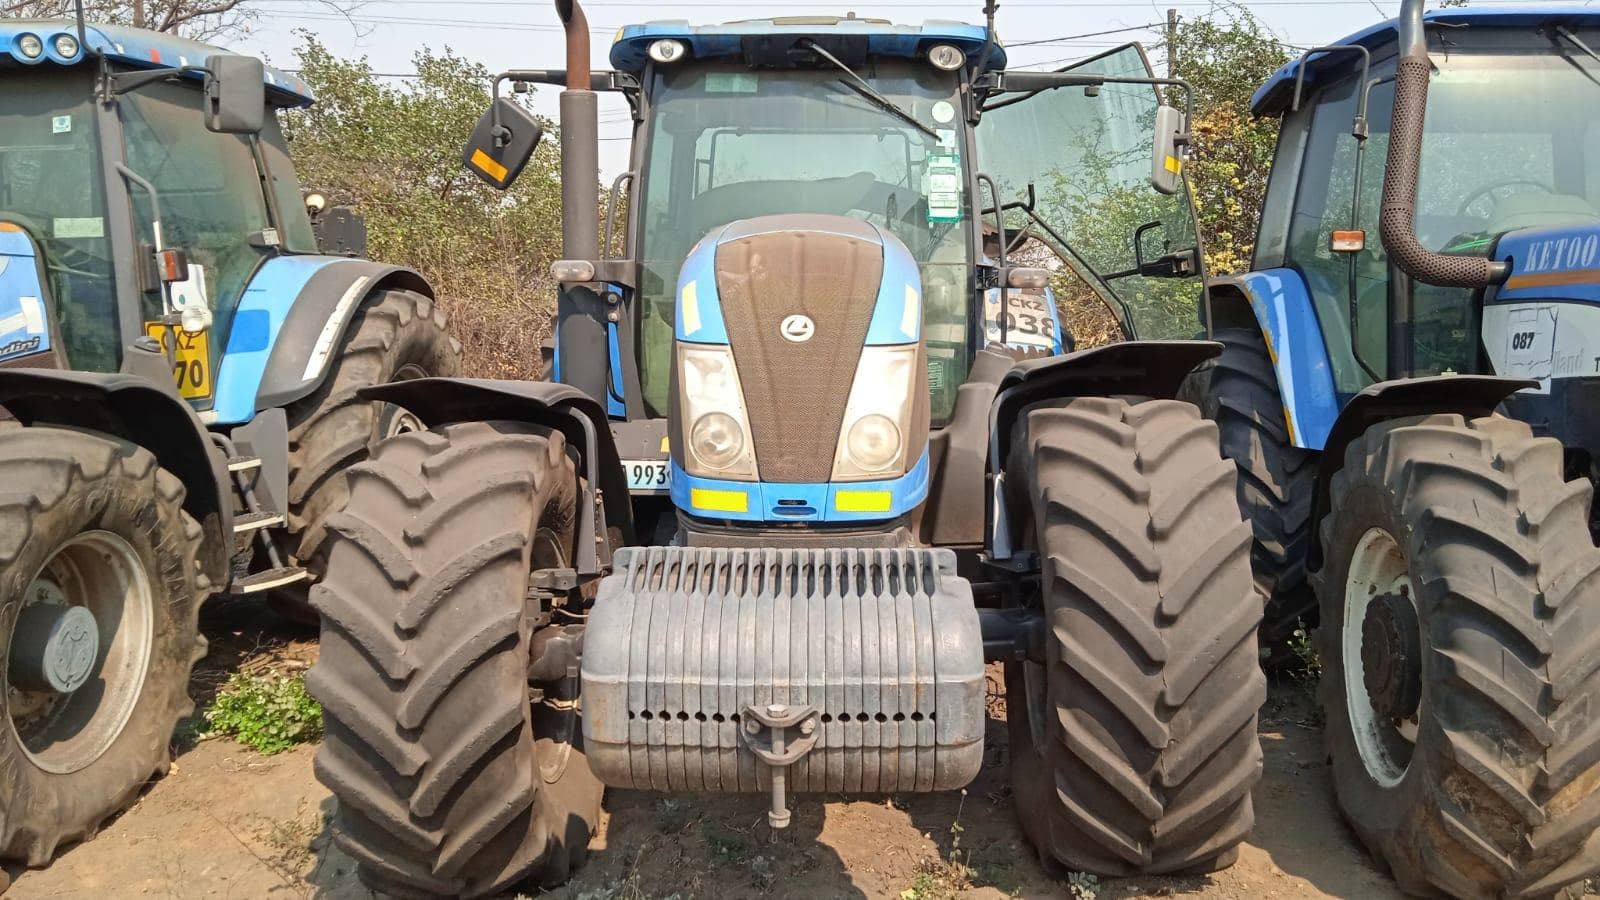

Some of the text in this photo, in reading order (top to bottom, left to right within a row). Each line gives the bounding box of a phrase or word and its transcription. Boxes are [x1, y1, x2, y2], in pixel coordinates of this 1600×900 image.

[0, 336, 40, 356] dini
[1512, 331, 1535, 350] 087
[173, 359, 203, 390] 70
[633, 464, 672, 485] 993
